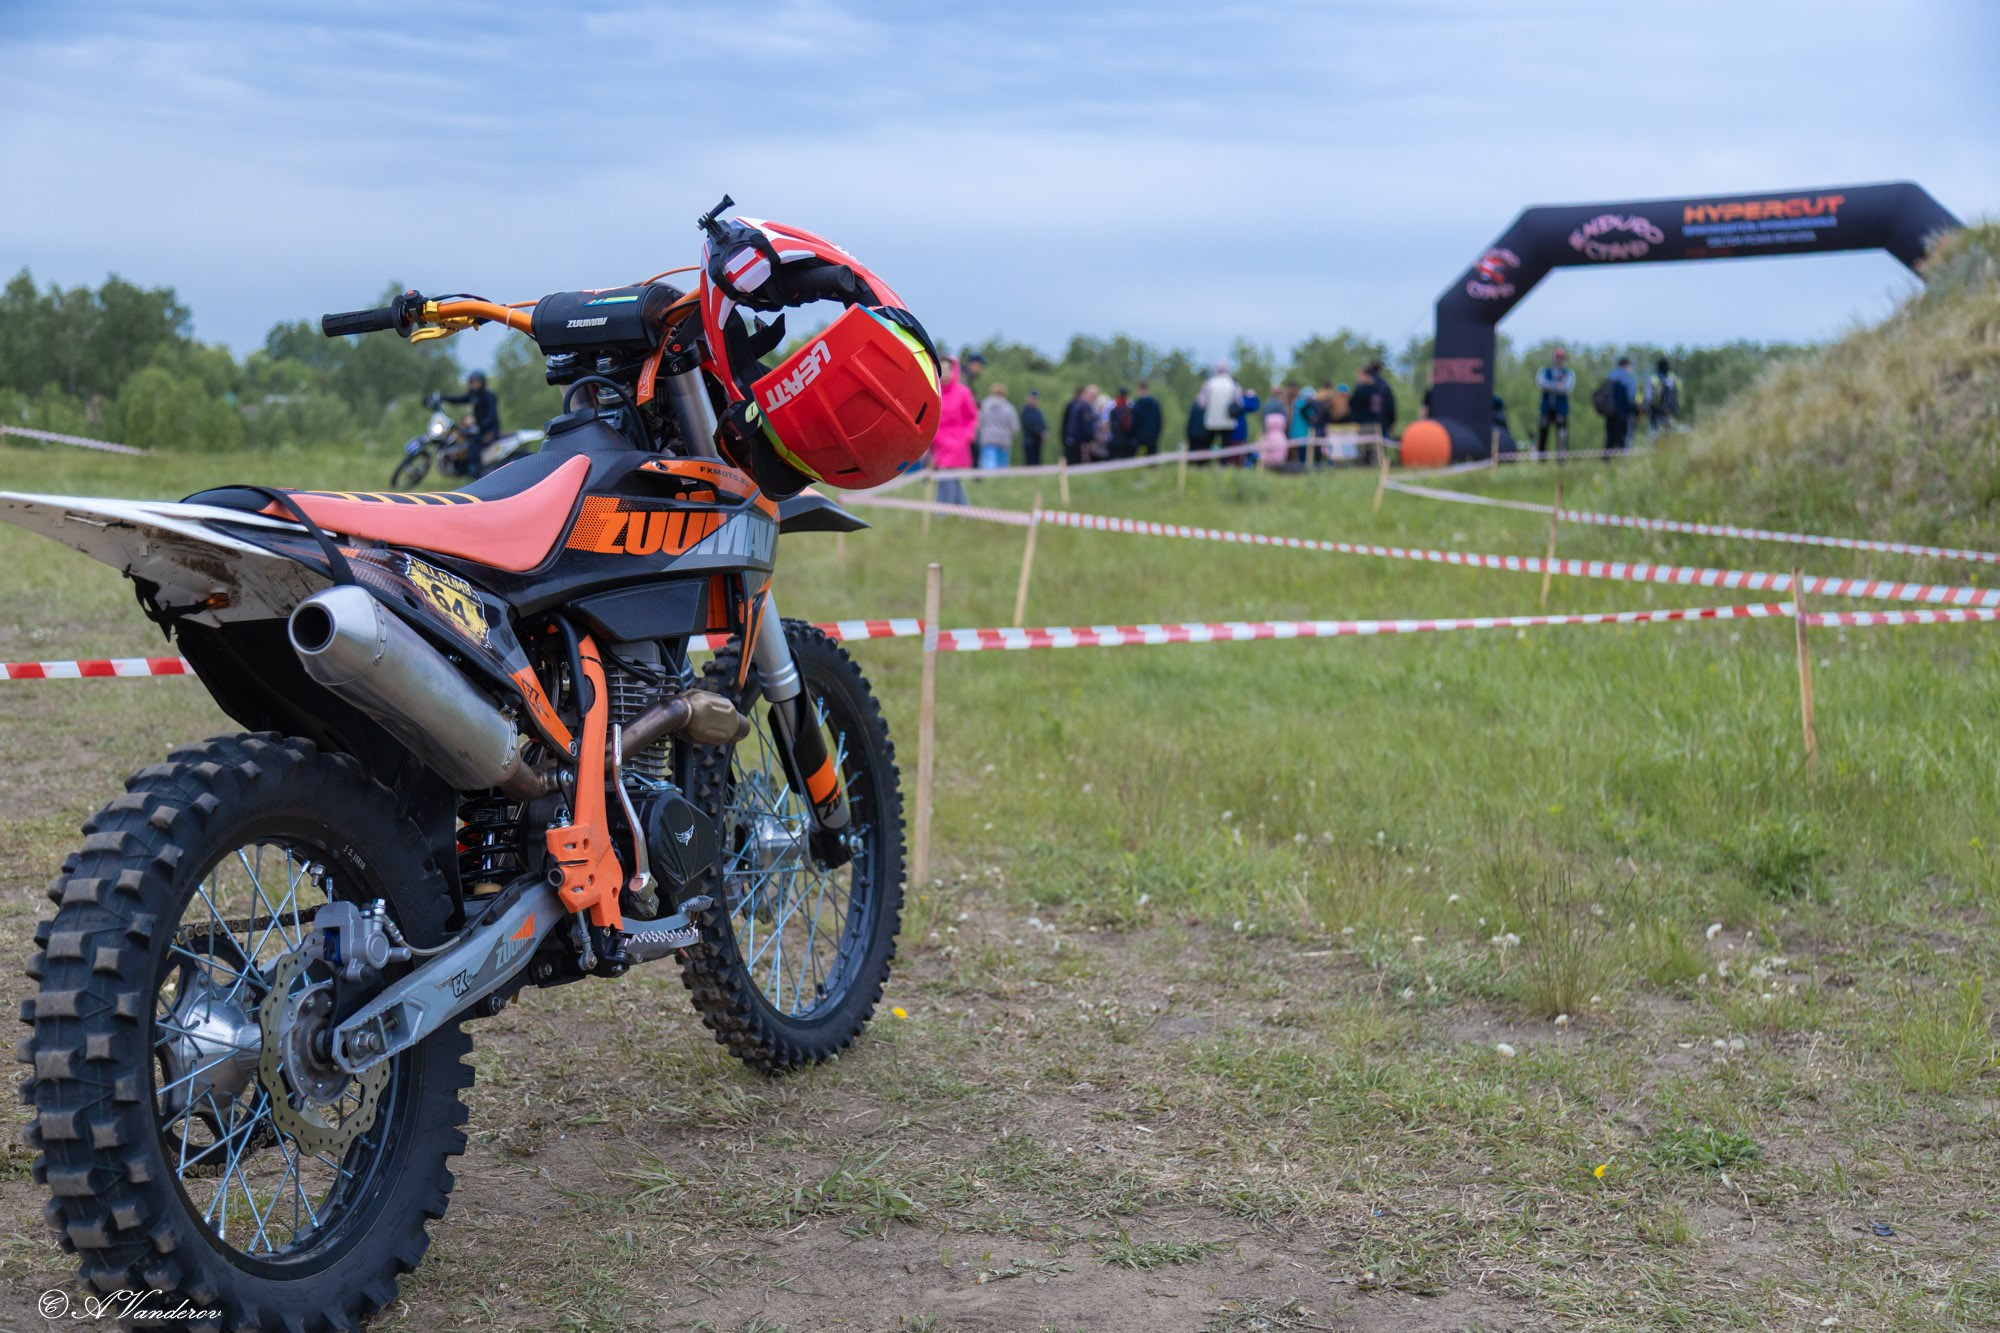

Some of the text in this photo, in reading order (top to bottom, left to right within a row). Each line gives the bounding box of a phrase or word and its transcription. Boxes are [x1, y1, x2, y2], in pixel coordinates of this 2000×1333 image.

[1683, 195, 1845, 224] HYPERCUT
[566, 316, 608, 329] ZUUMAV
[765, 340, 832, 413] LEATT
[700, 466, 750, 487] FXMOTO.RU
[592, 510, 774, 565] ZUUMAV
[413, 559, 472, 598] HILL CLIMB
[430, 583, 471, 628] 64
